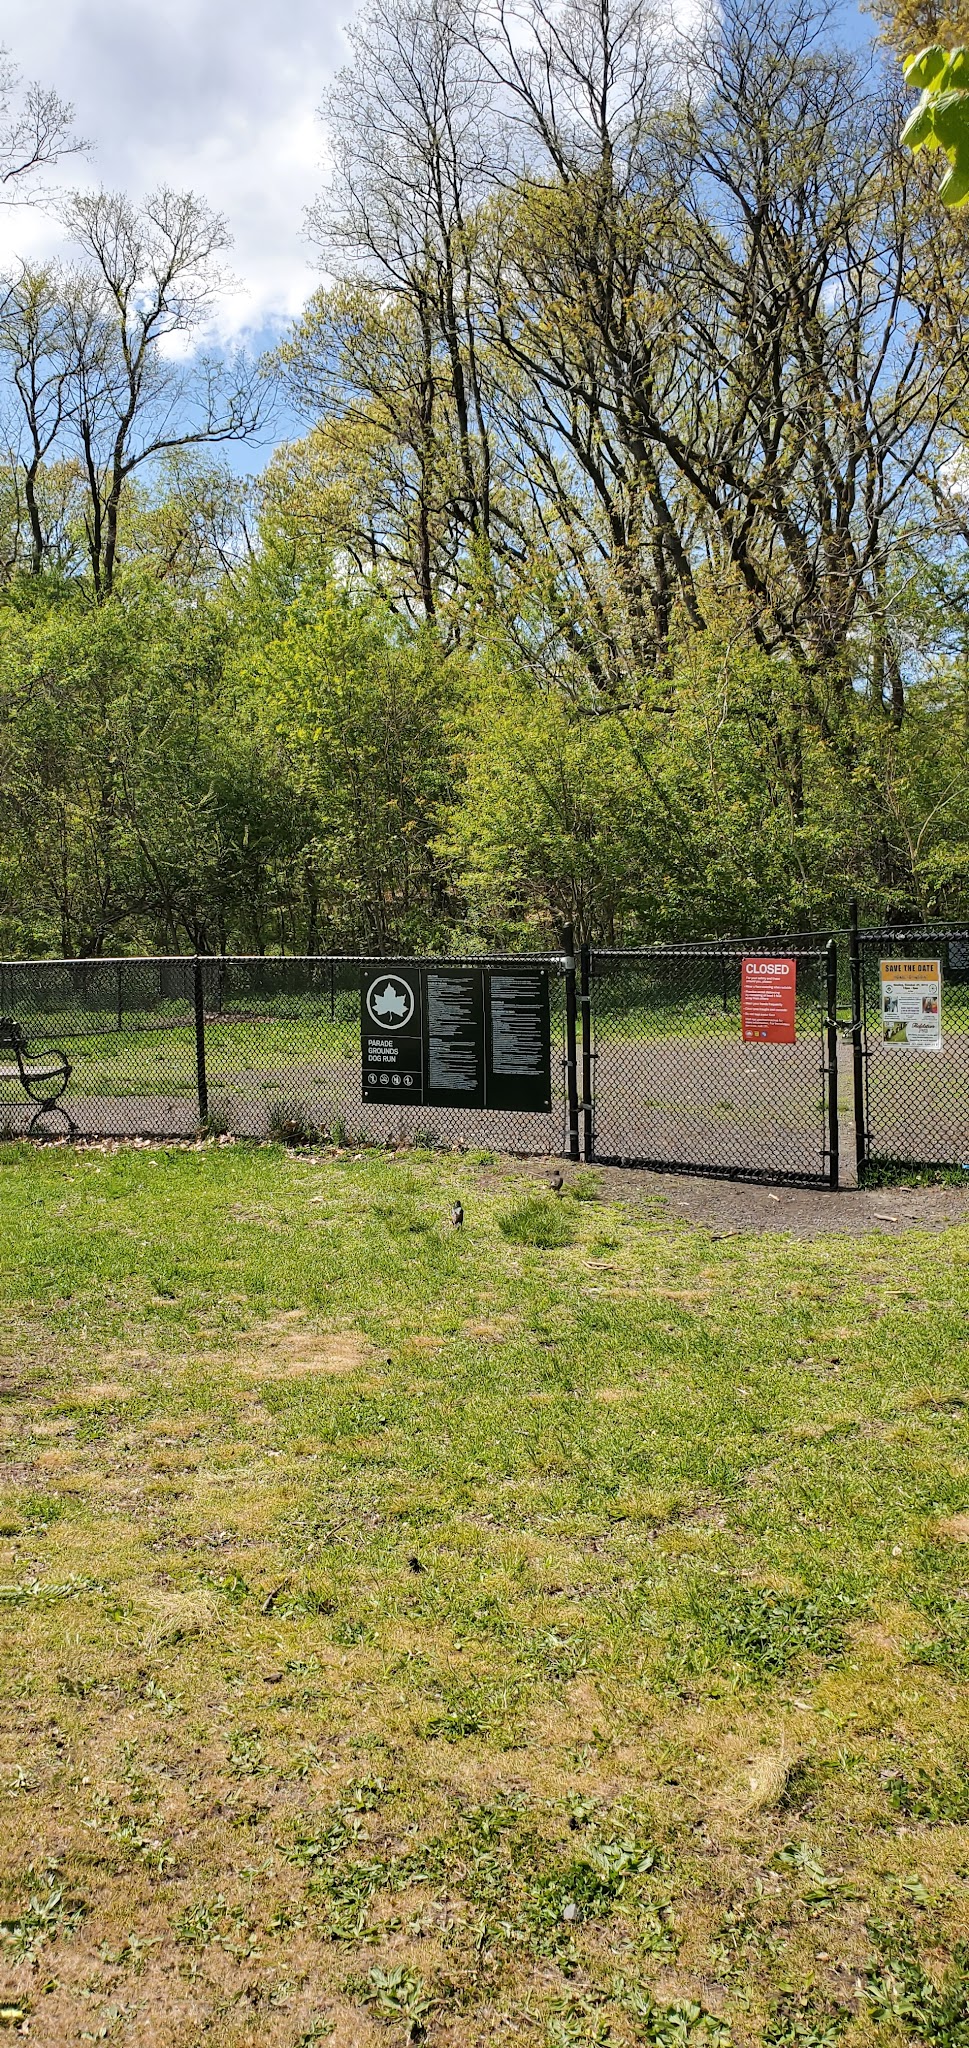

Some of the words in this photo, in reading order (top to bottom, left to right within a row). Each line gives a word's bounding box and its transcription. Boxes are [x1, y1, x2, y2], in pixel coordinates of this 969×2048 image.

[746, 963, 790, 975] CLOSED
[885, 964, 902, 972] SAVE
[904, 964, 916, 972] THE
[918, 964, 934, 972] DATE
[368, 1039, 393, 1047] PARADE
[368, 1047, 399, 1055] GROUNDS
[368, 1054, 381, 1062] DOG
